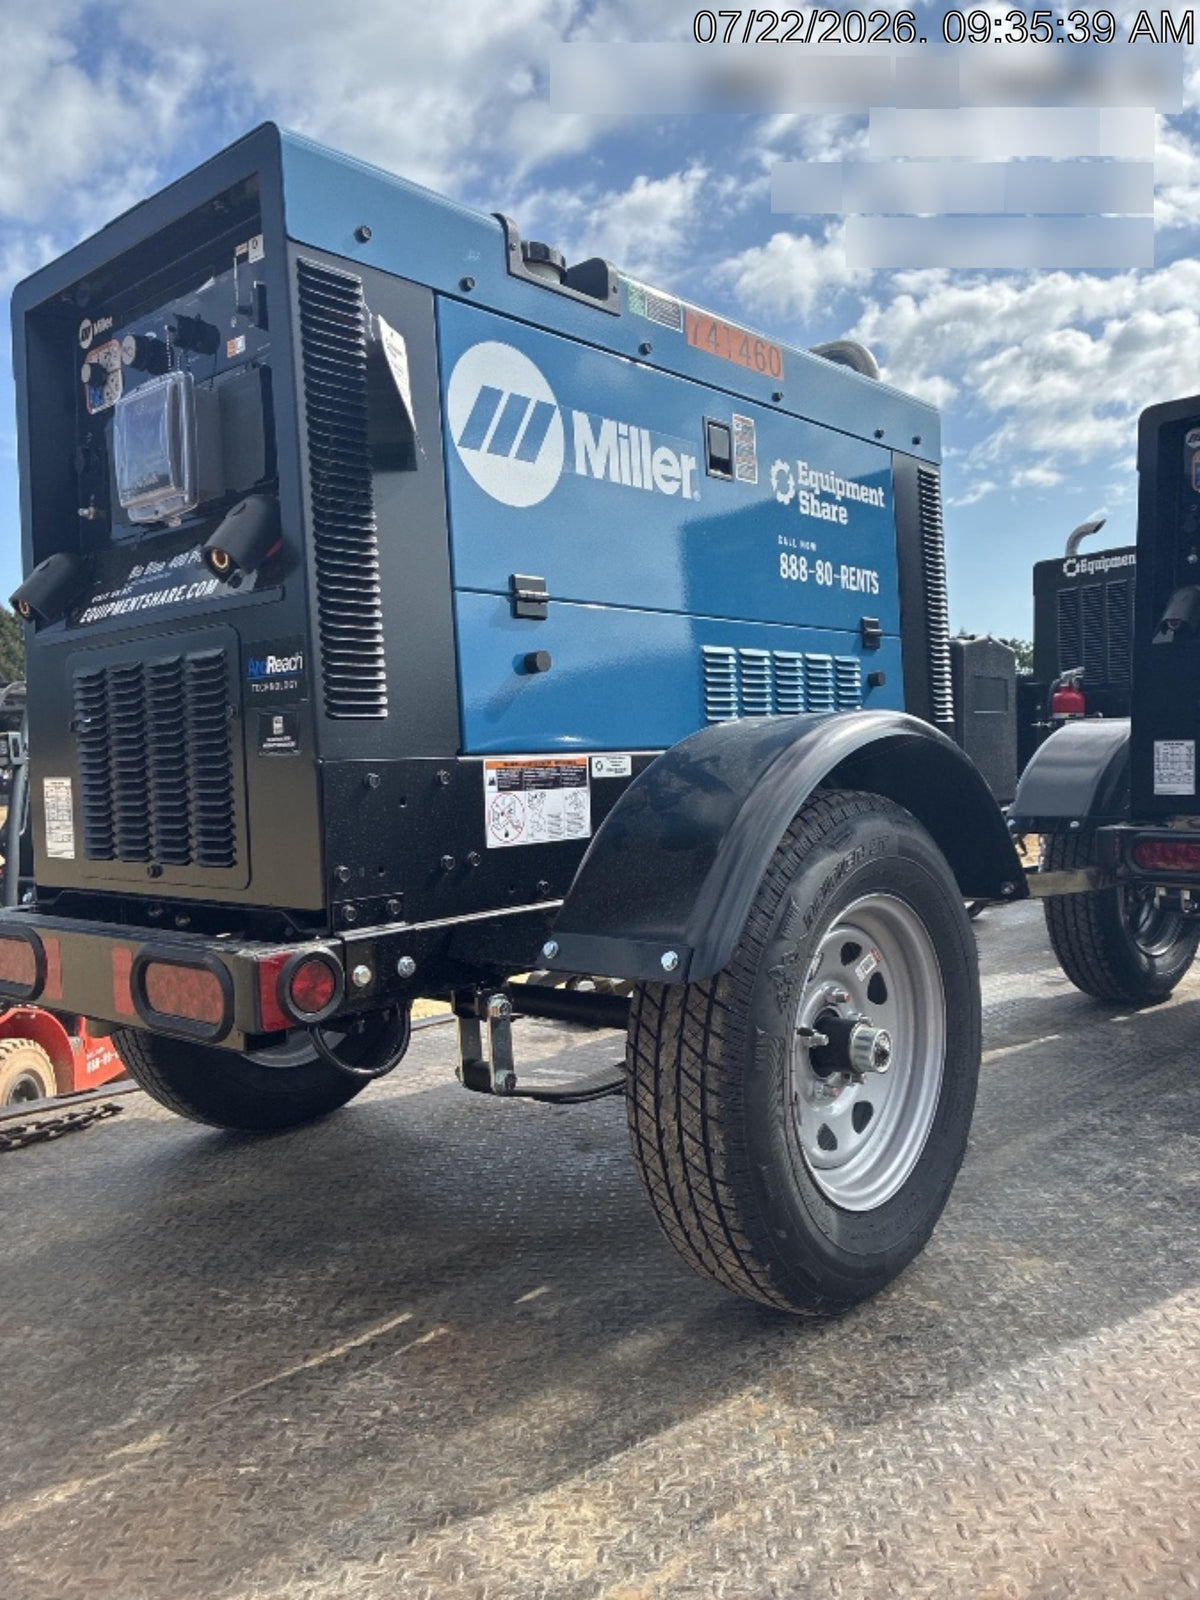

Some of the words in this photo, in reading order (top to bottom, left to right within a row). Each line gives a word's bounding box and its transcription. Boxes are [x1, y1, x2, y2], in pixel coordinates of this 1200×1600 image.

[572, 410, 697, 499] Miller
[797, 459, 886, 509] Equipment
[799, 489, 849, 525] Share
[780, 552, 880, 595] 888-80-RENTS
[1080, 553, 1136, 576] Equipmen
[79, 578, 219, 624] EQUIPMENTSHARE.COM
